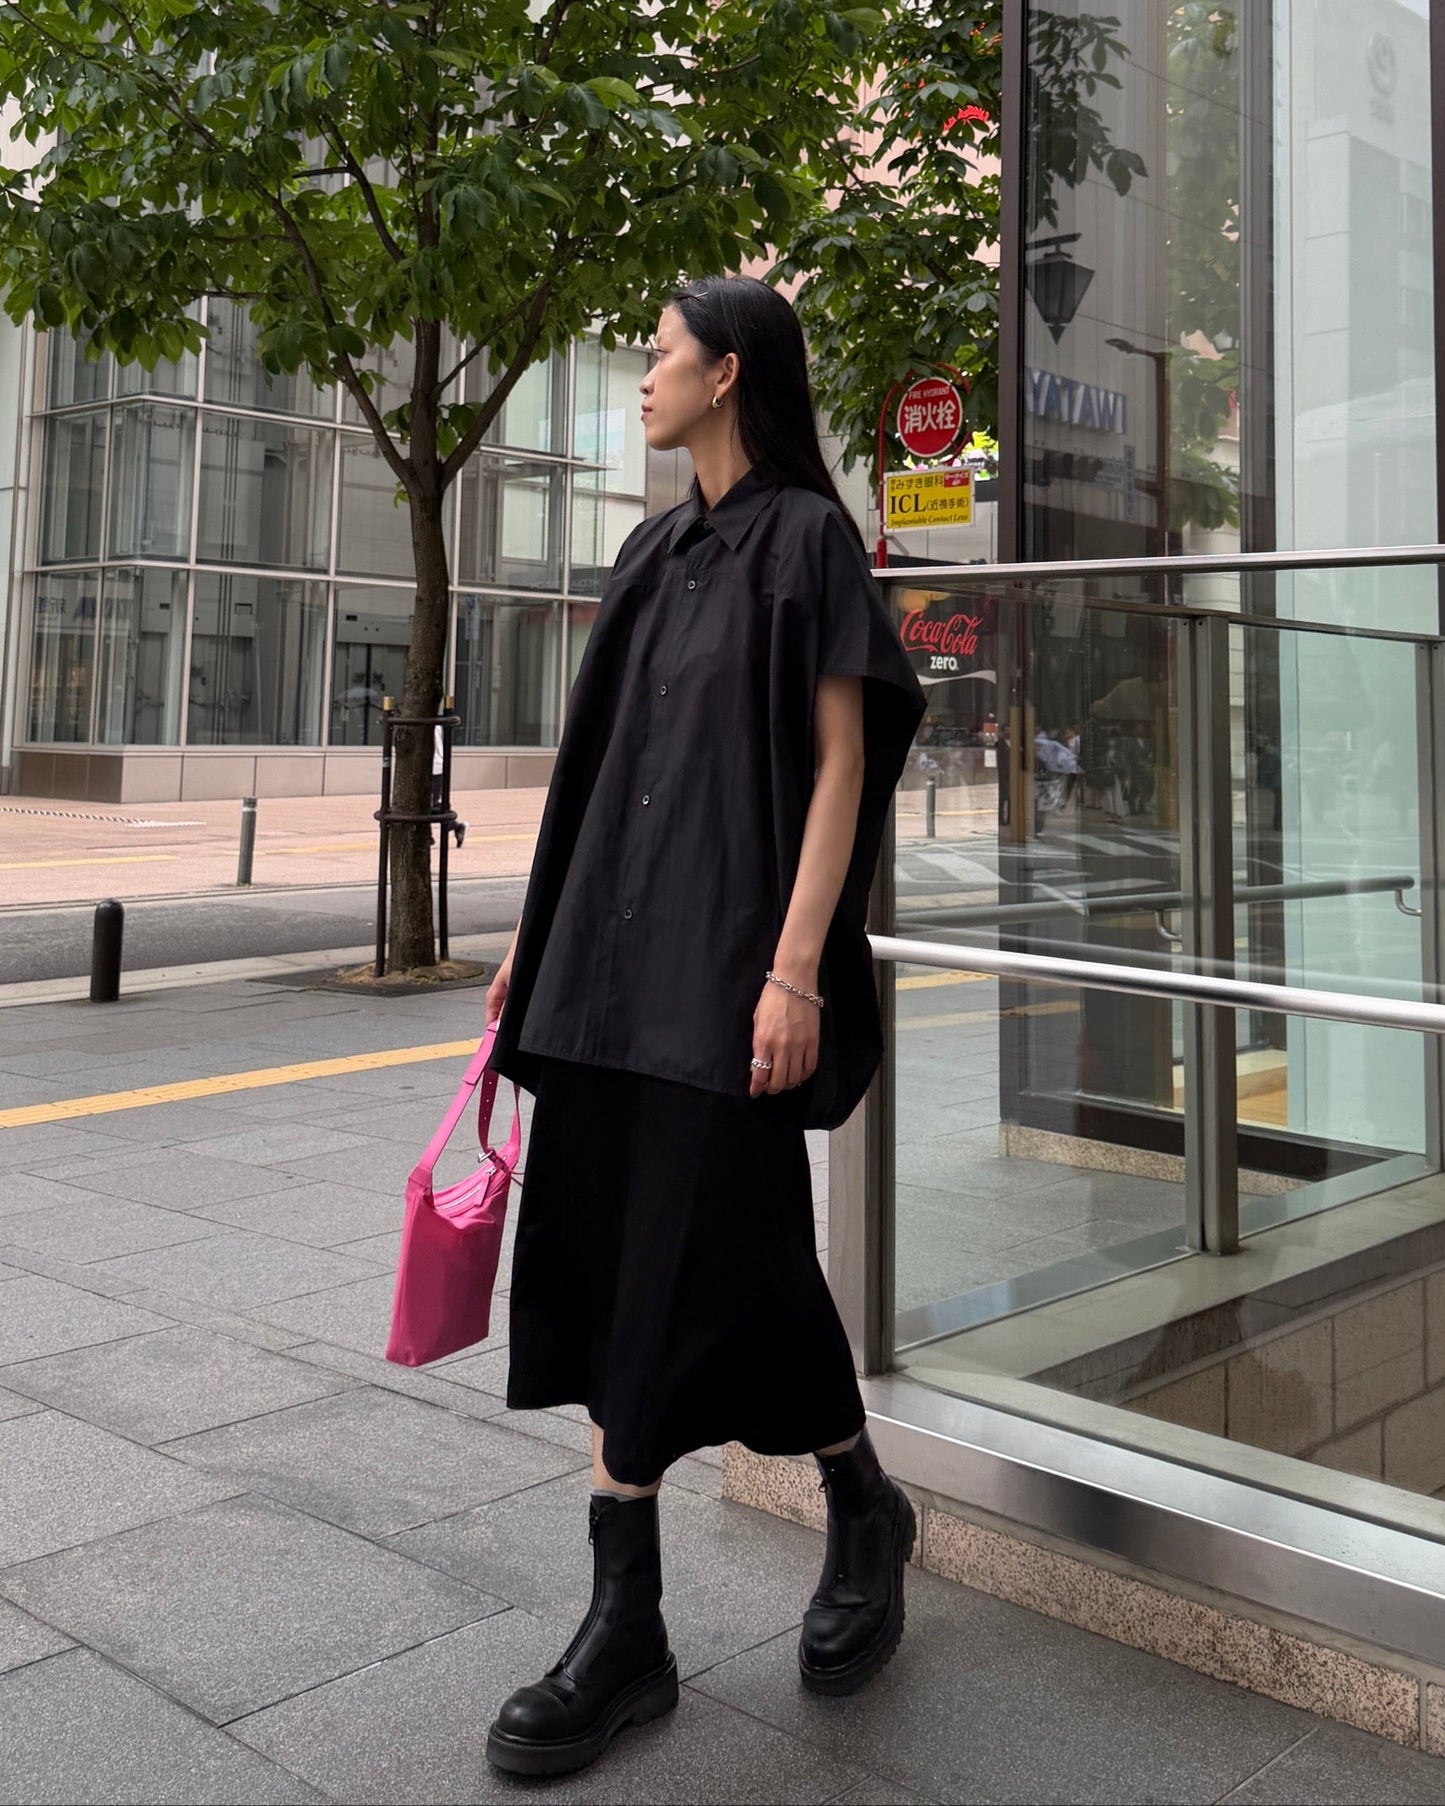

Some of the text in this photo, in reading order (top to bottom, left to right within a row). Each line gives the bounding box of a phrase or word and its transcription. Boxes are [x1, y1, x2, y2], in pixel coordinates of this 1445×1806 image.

[908, 386, 950, 400] FIRE HYDRANT
[903, 399, 957, 434] 消火栓
[890, 513, 969, 527] Implantable Contact Lens
[930, 656, 957, 671] zero
